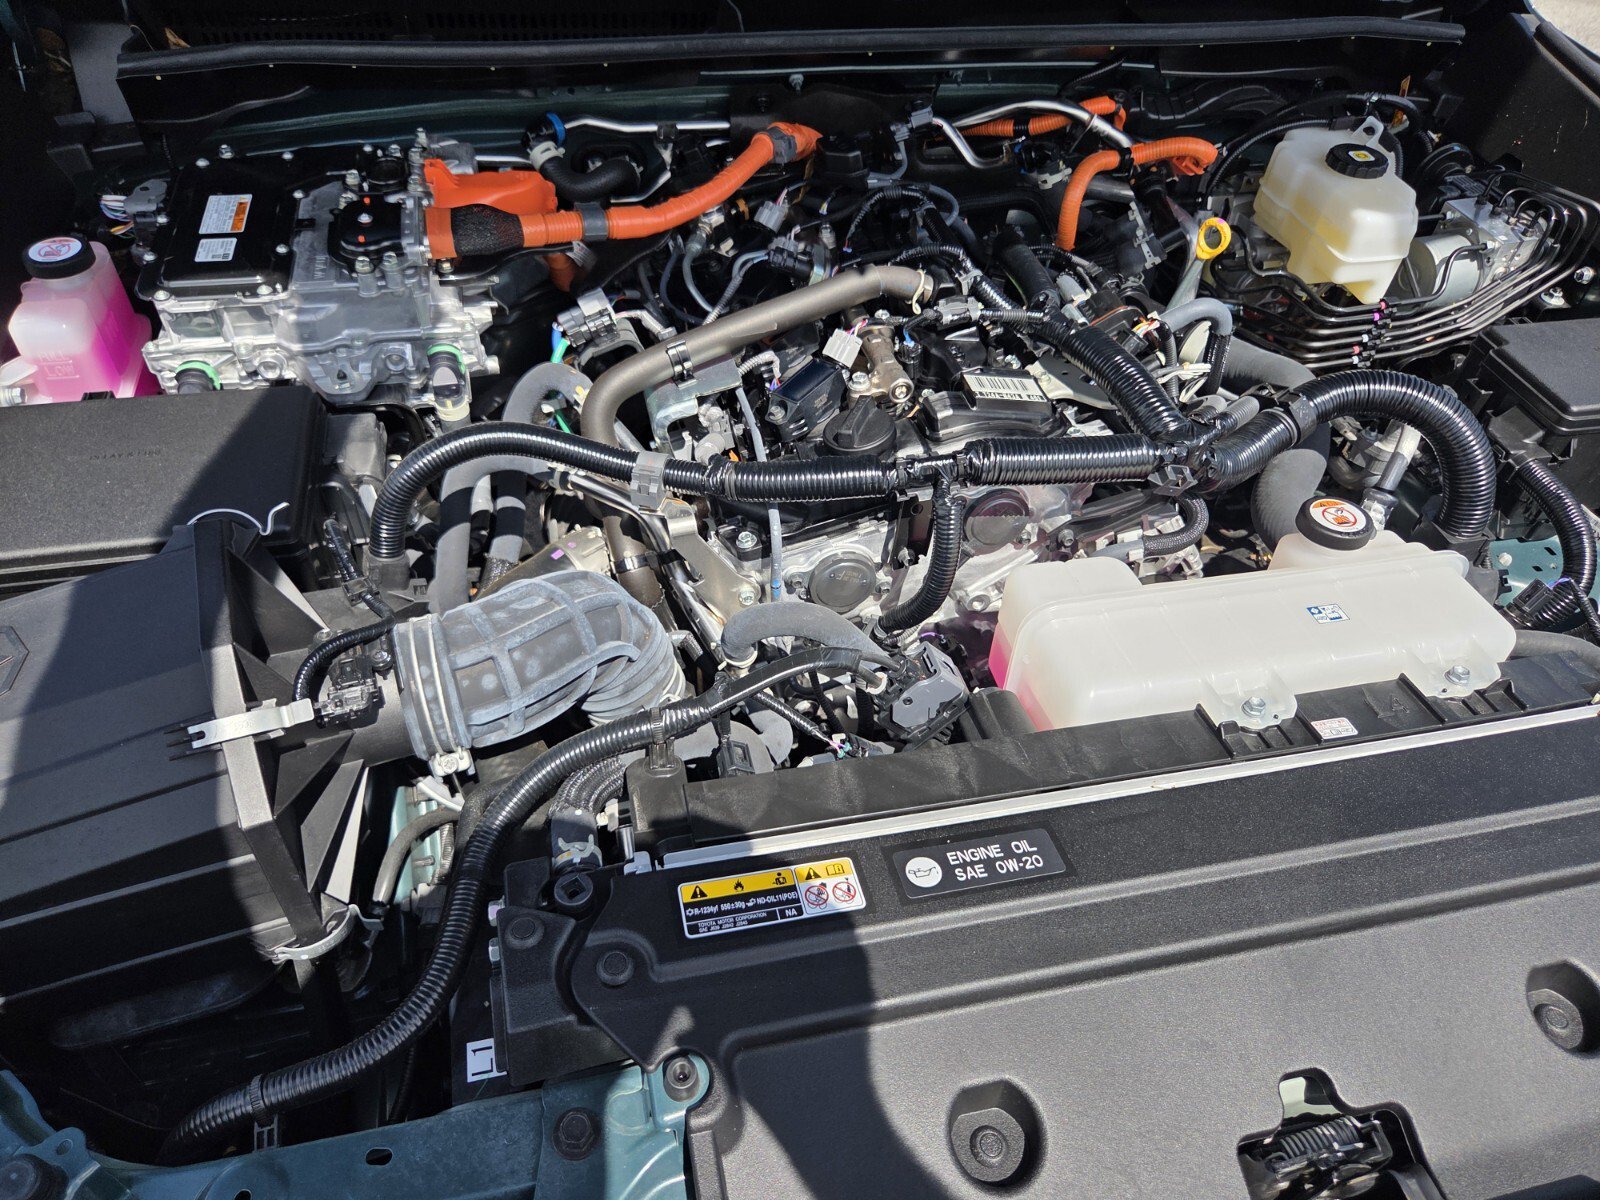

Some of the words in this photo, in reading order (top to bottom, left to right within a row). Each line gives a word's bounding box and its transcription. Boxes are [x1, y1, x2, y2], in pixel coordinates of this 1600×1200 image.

[44, 365, 75, 377] LOW
[946, 844, 1004, 865] ENGINE
[1011, 840, 1038, 854] OIL
[954, 864, 988, 881] SAE
[995, 854, 1044, 874] 0W-20
[698, 920, 717, 928] TOYOTA
[735, 912, 767, 921] CORPORATION
[785, 908, 798, 917] NA
